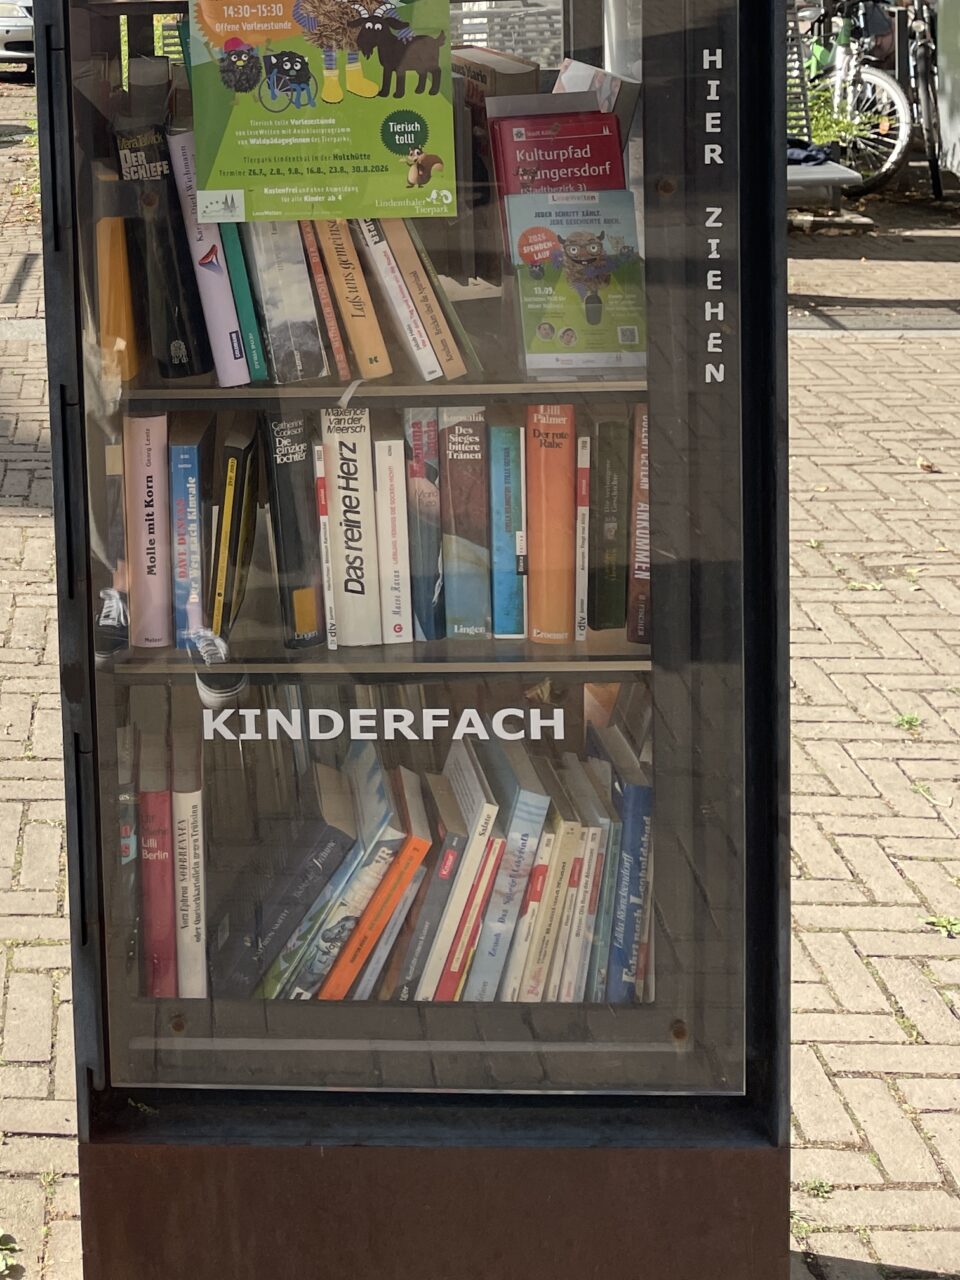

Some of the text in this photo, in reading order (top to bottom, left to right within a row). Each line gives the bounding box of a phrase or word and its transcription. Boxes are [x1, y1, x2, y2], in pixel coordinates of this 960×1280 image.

[215, 20, 292, 32] Offene Vorlesestunde
[388, 122, 421, 132] Tierisch
[395, 133, 415, 144] toll!
[120, 149, 147, 167] DER
[516, 144, 591, 162] Kulturpfad
[123, 160, 170, 180] SCHIEFE
[376, 199, 426, 207] Lindenthaler
[415, 206, 448, 215] Tierpark
[702, 49, 725, 383] HIER ZIEHEN
[534, 251, 550, 260] LAUF
[343, 272, 366, 320] Laß uns
[541, 405, 560, 415] Lilli
[329, 416, 363, 426] van der
[533, 414, 568, 425] Palmer
[326, 424, 366, 434] Meersch
[455, 426, 473, 435] Des
[533, 429, 569, 439] Der rote
[275, 437, 292, 447] Die
[449, 434, 480, 445] Sieges
[540, 439, 563, 449] Rabe
[275, 443, 308, 456] einzige
[448, 442, 480, 452] bittere
[274, 452, 307, 464] Tochter
[447, 450, 482, 460] Tränen
[338, 441, 366, 596] Das reine Herz
[144, 474, 157, 576] Molle mit Korn
[190, 522, 198, 551] nach
[634, 502, 650, 580] ANKUMMEN
[578, 616, 586, 631] dtv
[454, 625, 486, 635] Lingen
[203, 708, 565, 740] KINDERFACH
[479, 812, 492, 837] Salate
[142, 836, 158, 848] Lilli
[142, 849, 169, 860] Berlin
